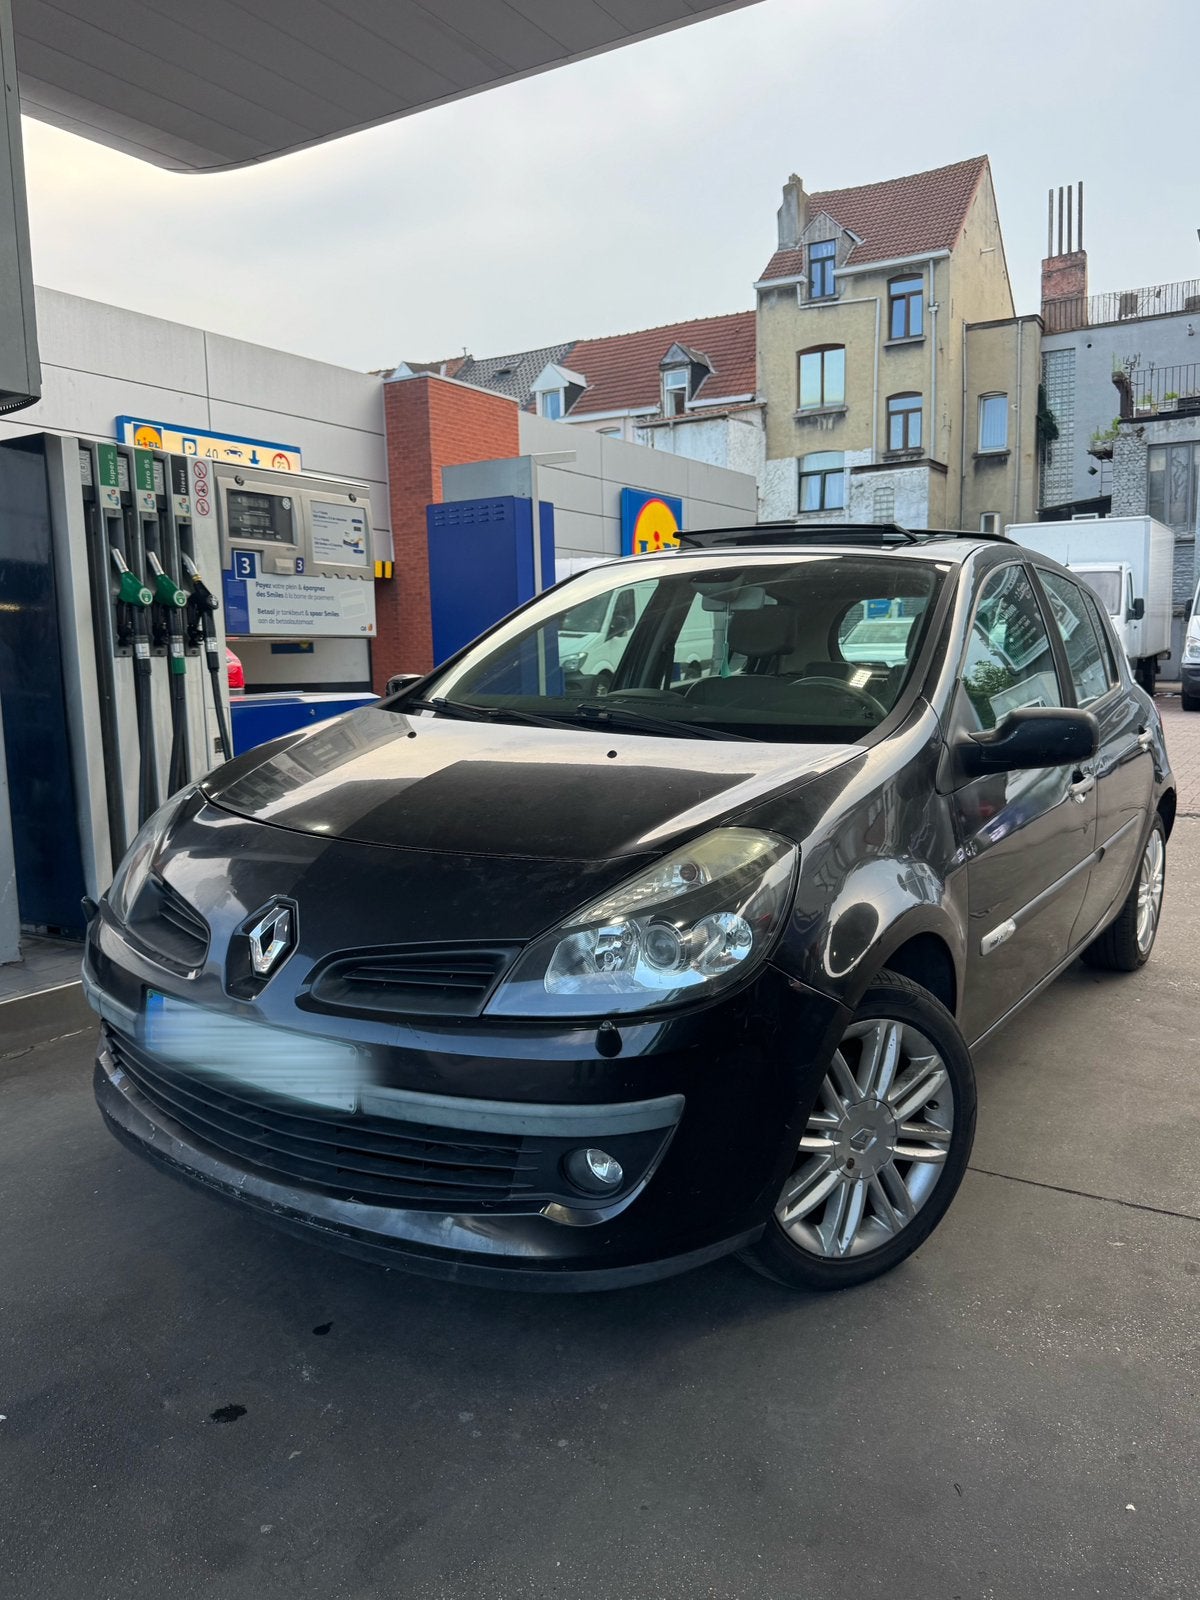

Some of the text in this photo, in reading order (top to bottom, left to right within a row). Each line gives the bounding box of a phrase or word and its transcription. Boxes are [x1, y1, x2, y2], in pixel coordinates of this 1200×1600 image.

[240, 557, 250, 574] 3
[297, 560, 303, 571] 3
[256, 581, 271, 589] Payez
